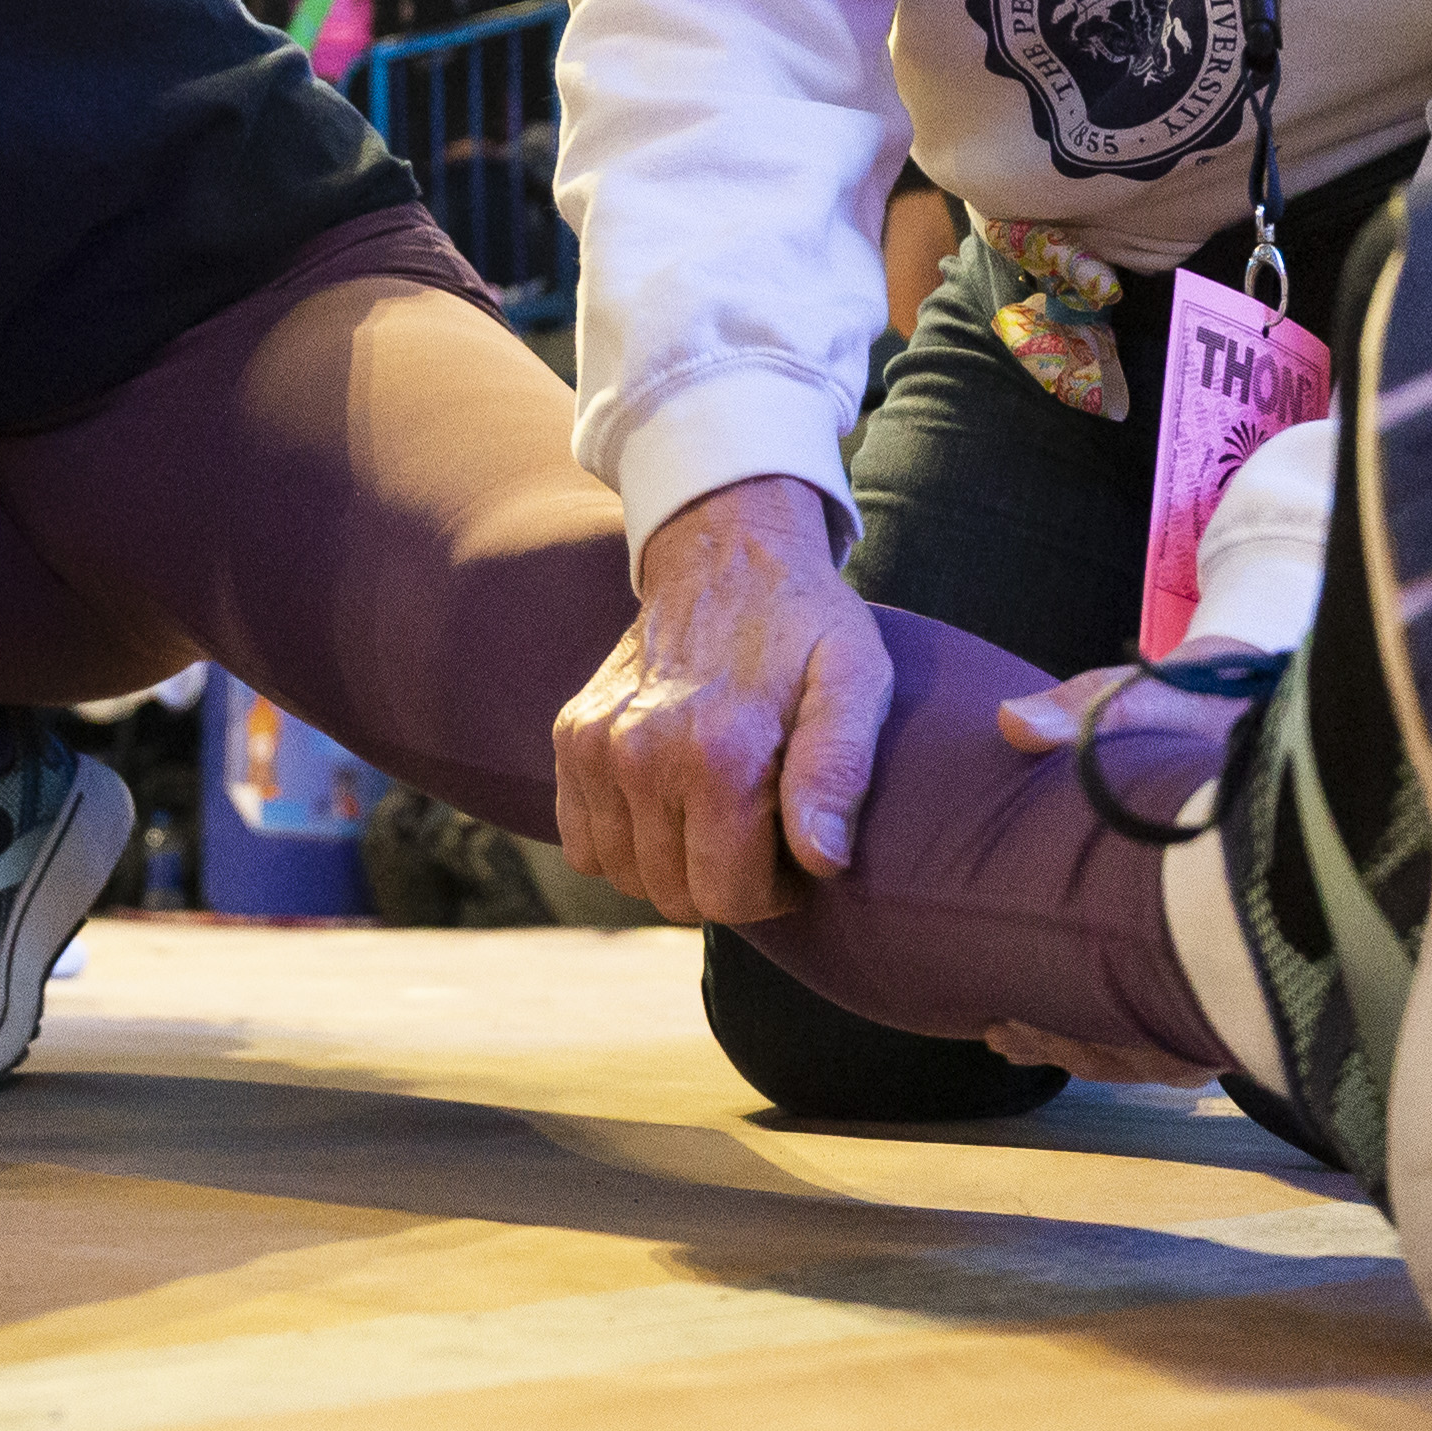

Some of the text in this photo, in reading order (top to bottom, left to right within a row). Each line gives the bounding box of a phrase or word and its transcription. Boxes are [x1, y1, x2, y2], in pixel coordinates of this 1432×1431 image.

[1023, 42, 1075, 103] THE
[1069, 120, 1120, 156] 1855
[1196, 325, 1307, 425] THON
